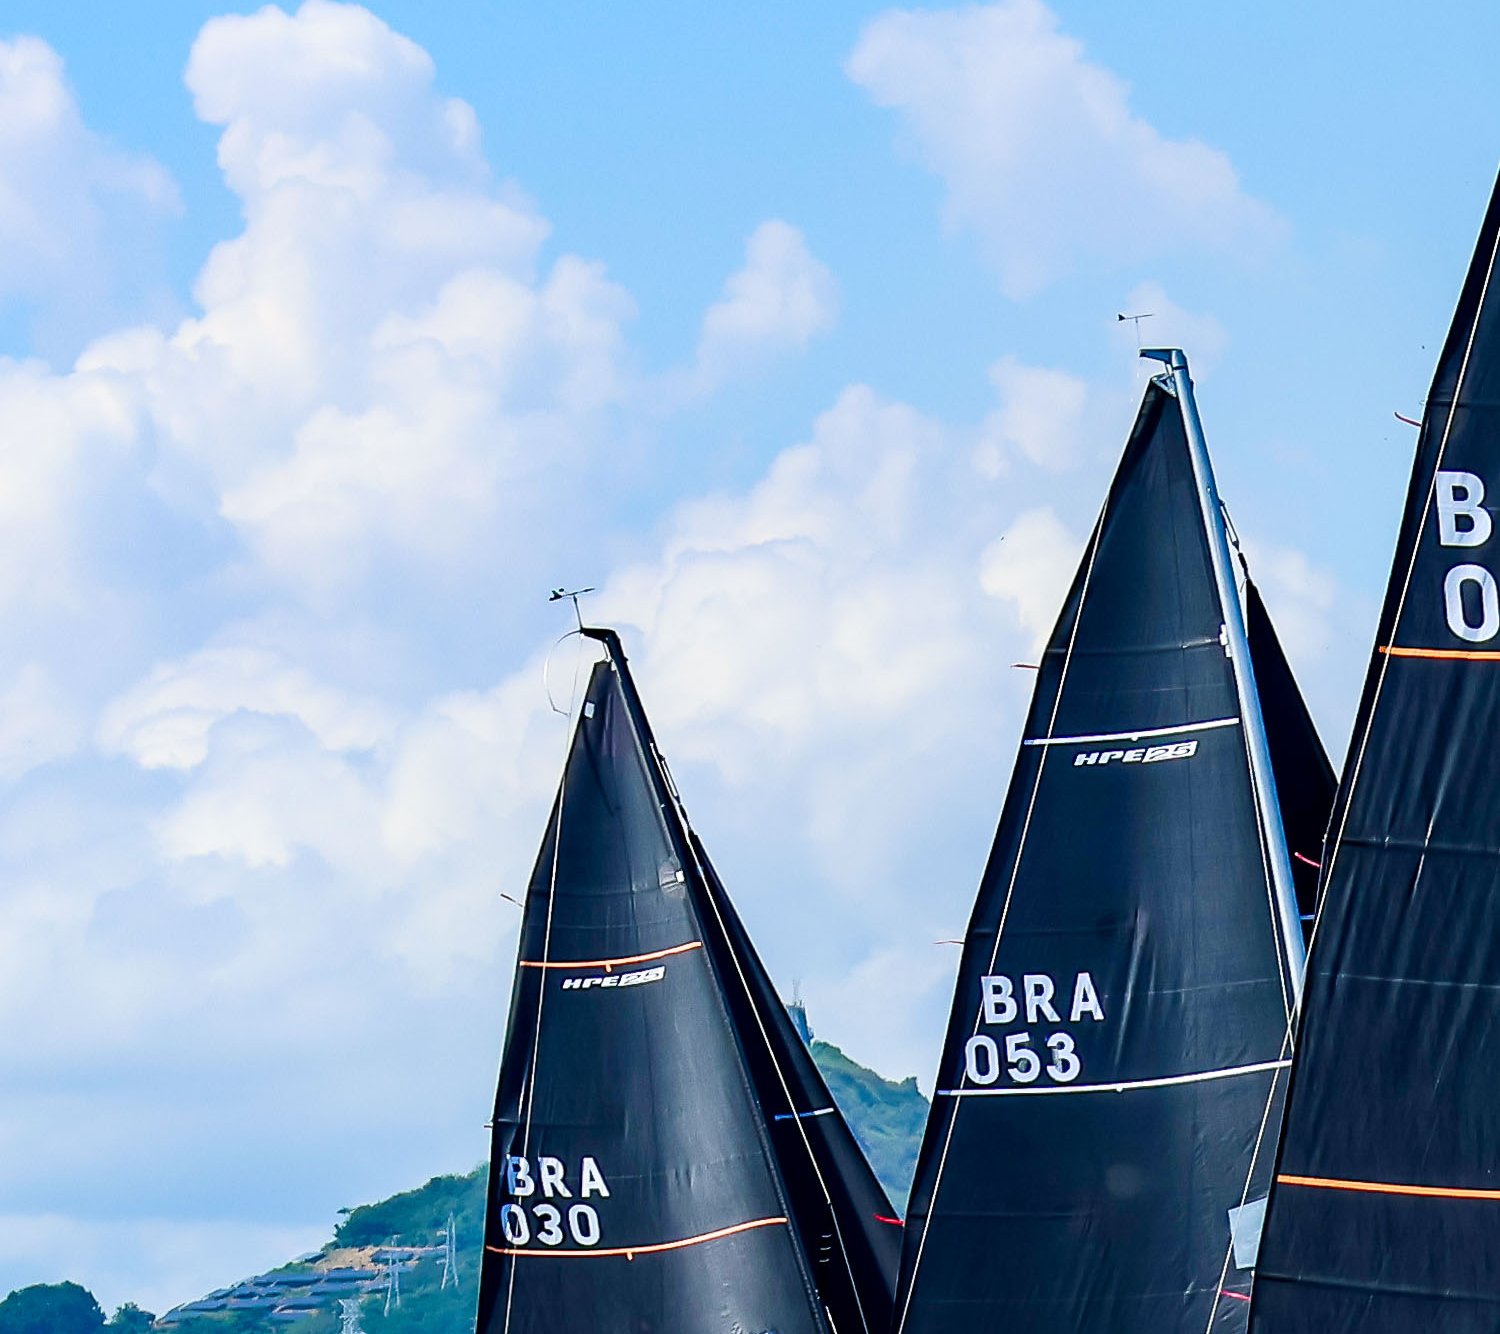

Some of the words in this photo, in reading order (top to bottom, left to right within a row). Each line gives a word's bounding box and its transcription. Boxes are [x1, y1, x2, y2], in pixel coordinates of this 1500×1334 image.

[980, 972, 1105, 1024] BRA
[965, 1032, 1081, 1085] 053
[507, 1156, 611, 1197] BRA
[501, 1203, 600, 1246] 030
